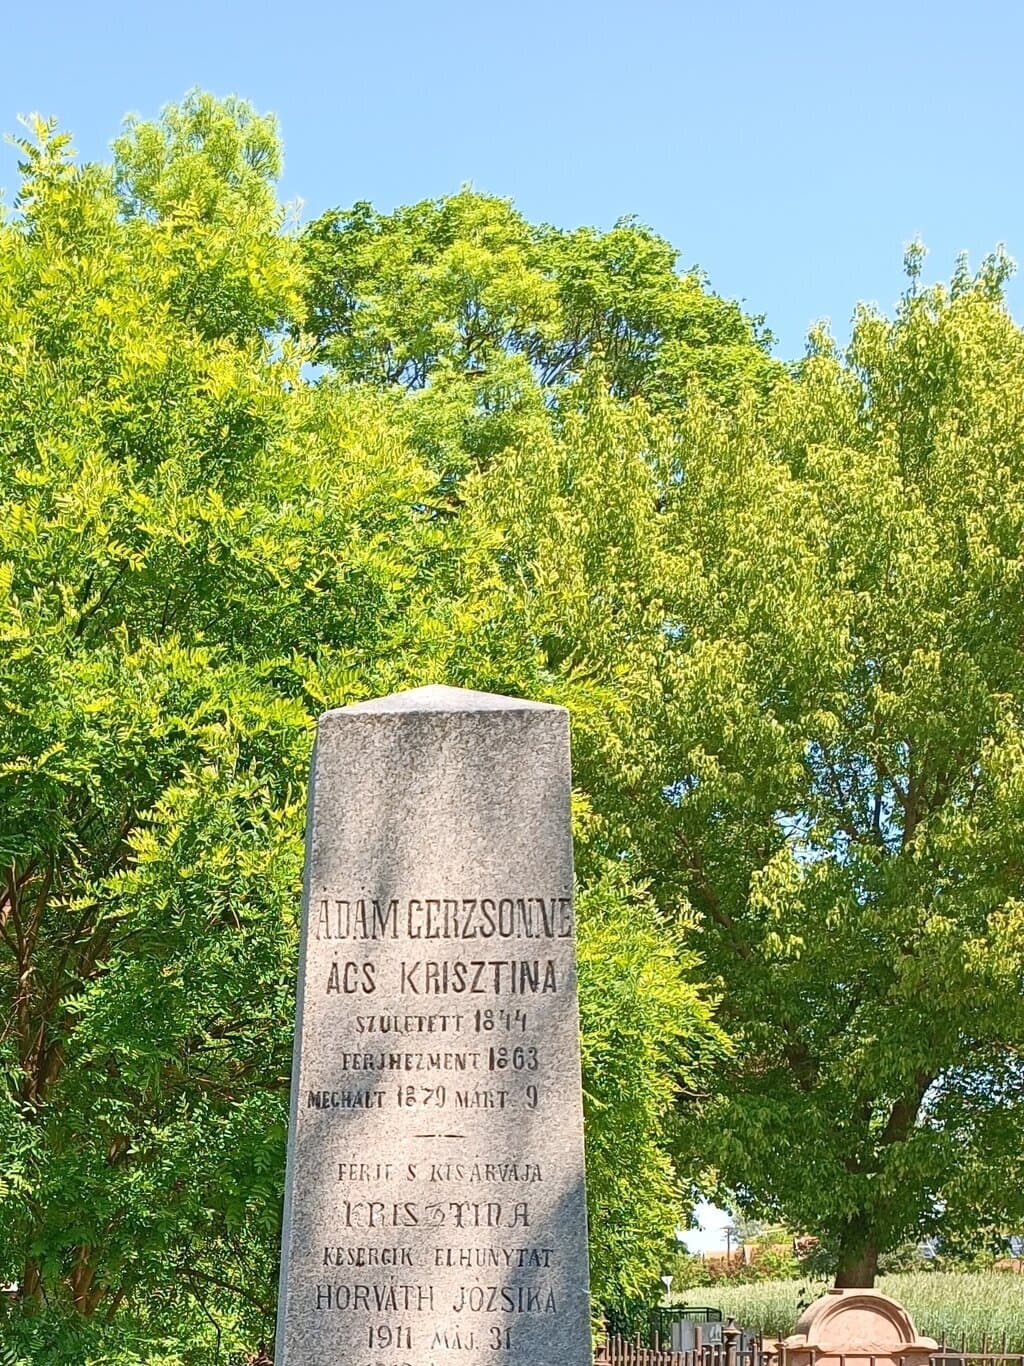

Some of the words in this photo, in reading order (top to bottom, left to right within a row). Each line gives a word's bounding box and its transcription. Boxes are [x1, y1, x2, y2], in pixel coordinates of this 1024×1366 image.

[316, 885, 399, 940] ÁDÁM
[326, 951, 377, 995] ÁCS
[401, 960, 557, 995] KRISZTINA
[489, 1047, 538, 1071] 1863
[397, 1085, 446, 1108] 1879
[407, 1164, 417, 1181] S
[315, 1278, 434, 1312] HORVÁTH
[453, 1278, 556, 1313] JÓZSIKA
[368, 1326, 412, 1350] 1911
